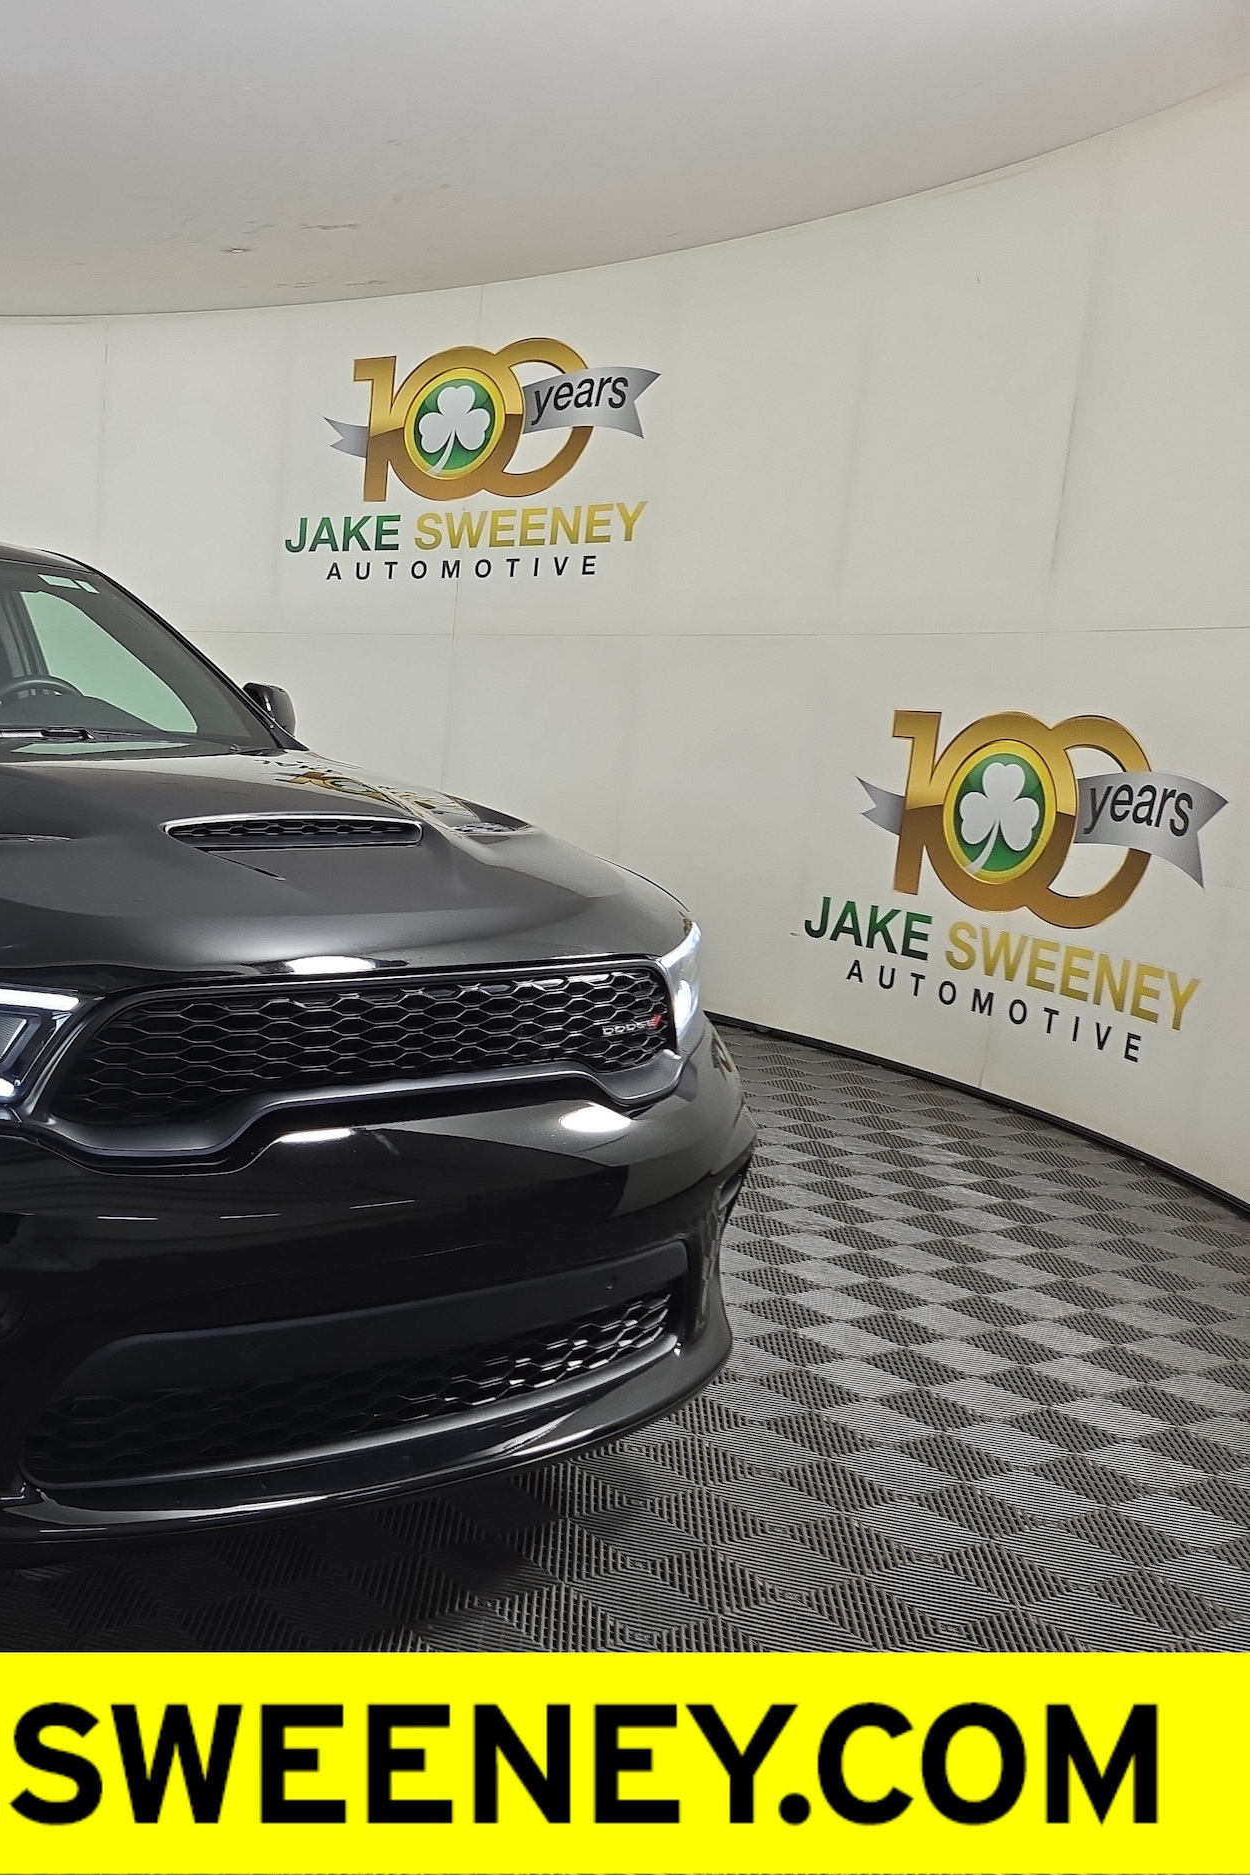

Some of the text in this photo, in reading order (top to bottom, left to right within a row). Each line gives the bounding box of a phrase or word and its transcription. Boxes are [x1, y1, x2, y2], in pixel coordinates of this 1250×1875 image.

[530, 376, 629, 426] years
[284, 501, 648, 553] JAKE SWEENEY
[326, 555, 598, 581] AUTOMOTIVE
[1083, 782, 1194, 837] years
[804, 896, 1201, 1032] JAKE SWEENEY
[846, 959, 1142, 1063] AUTOMOTIVE
